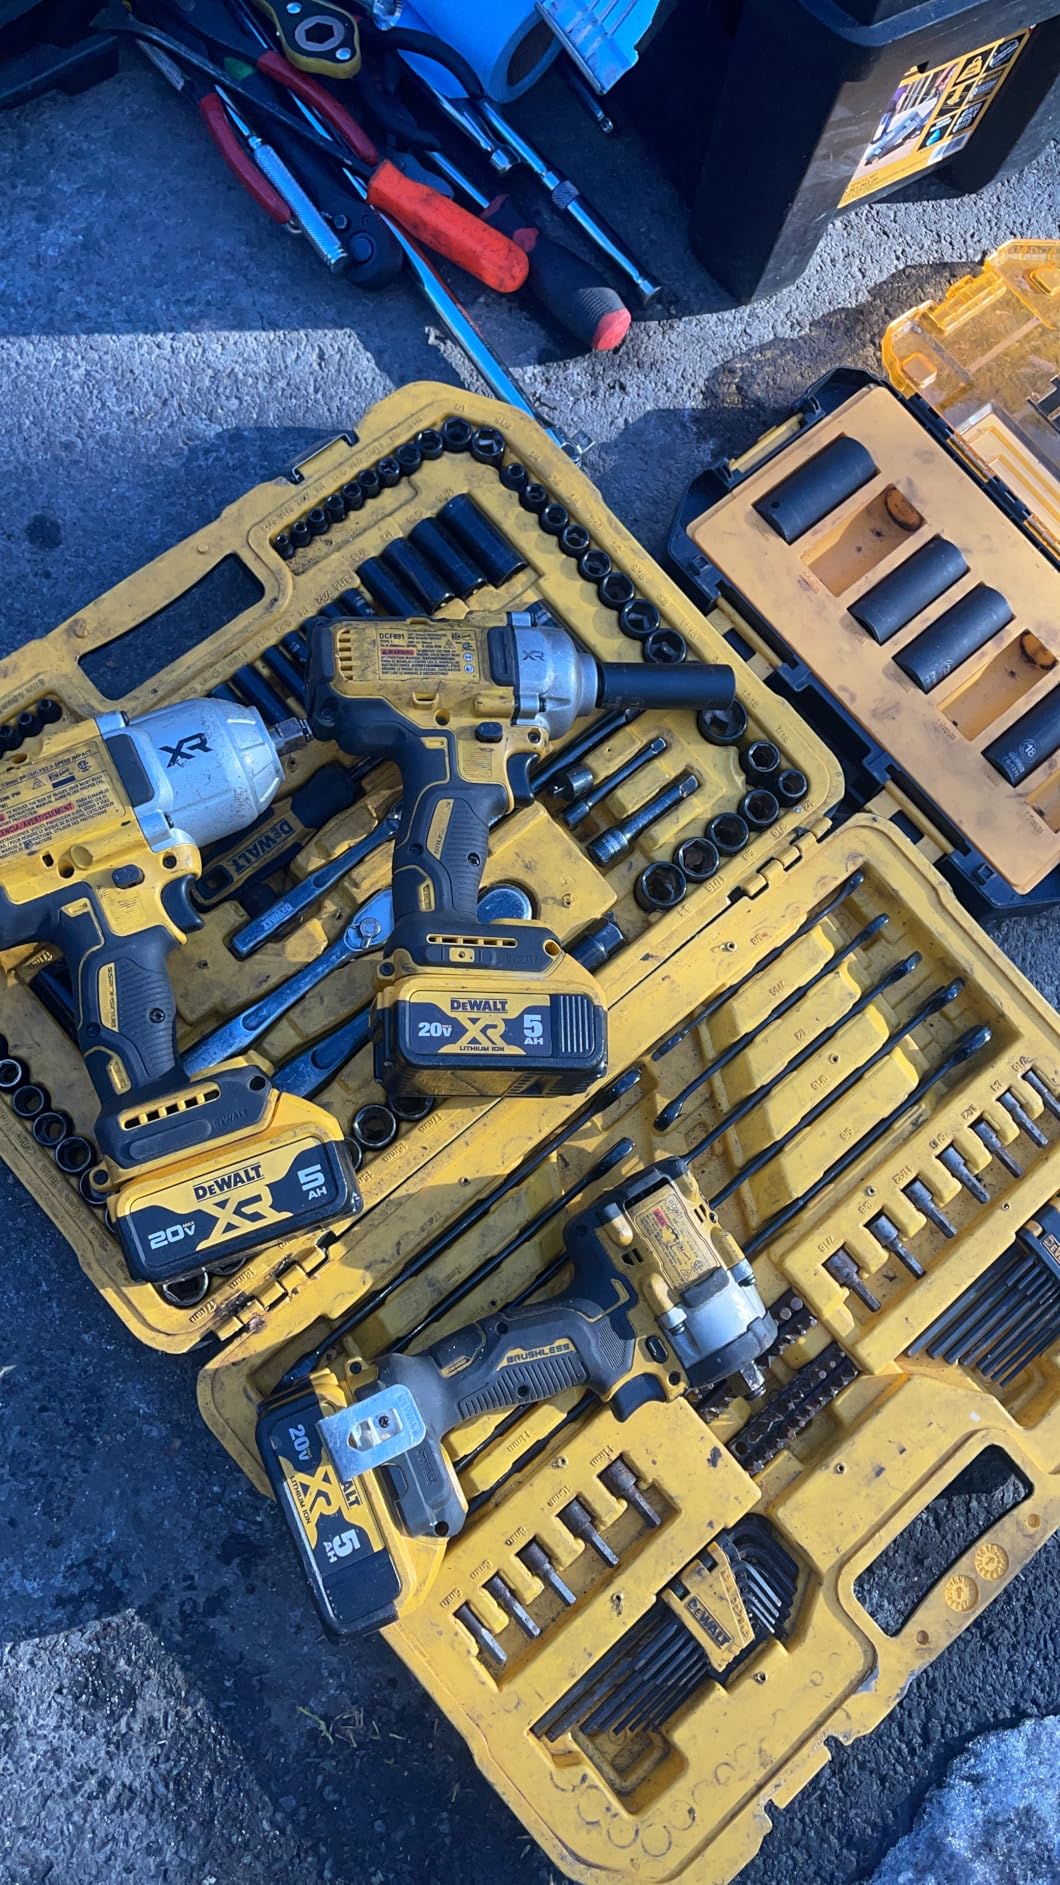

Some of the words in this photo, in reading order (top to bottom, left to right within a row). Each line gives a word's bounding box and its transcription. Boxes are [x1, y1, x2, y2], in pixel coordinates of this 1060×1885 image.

[521, 649, 545, 662] XR
[159, 732, 214, 769] XR
[231, 819, 296, 874] DEWALT
[451, 999, 508, 1012] DEWALT
[418, 1022, 452, 1037] 20V
[456, 1017, 508, 1047] XR
[523, 1015, 543, 1037] 5
[524, 1037, 544, 1045] AH
[193, 1164, 264, 1200] DEWALT
[308, 1187, 328, 1201] AH
[148, 1224, 196, 1250] 20V
[196, 1184, 294, 1251] XR
[298, 1164, 325, 1191] 5
[507, 1343, 570, 1364] BRUSHLESS
[289, 1424, 311, 1461] 20V
[293, 1464, 341, 1516] XR
[323, 1541, 338, 1563] AH
[332, 1529, 361, 1557] 5
[687, 1597, 732, 1647] DEWALT
